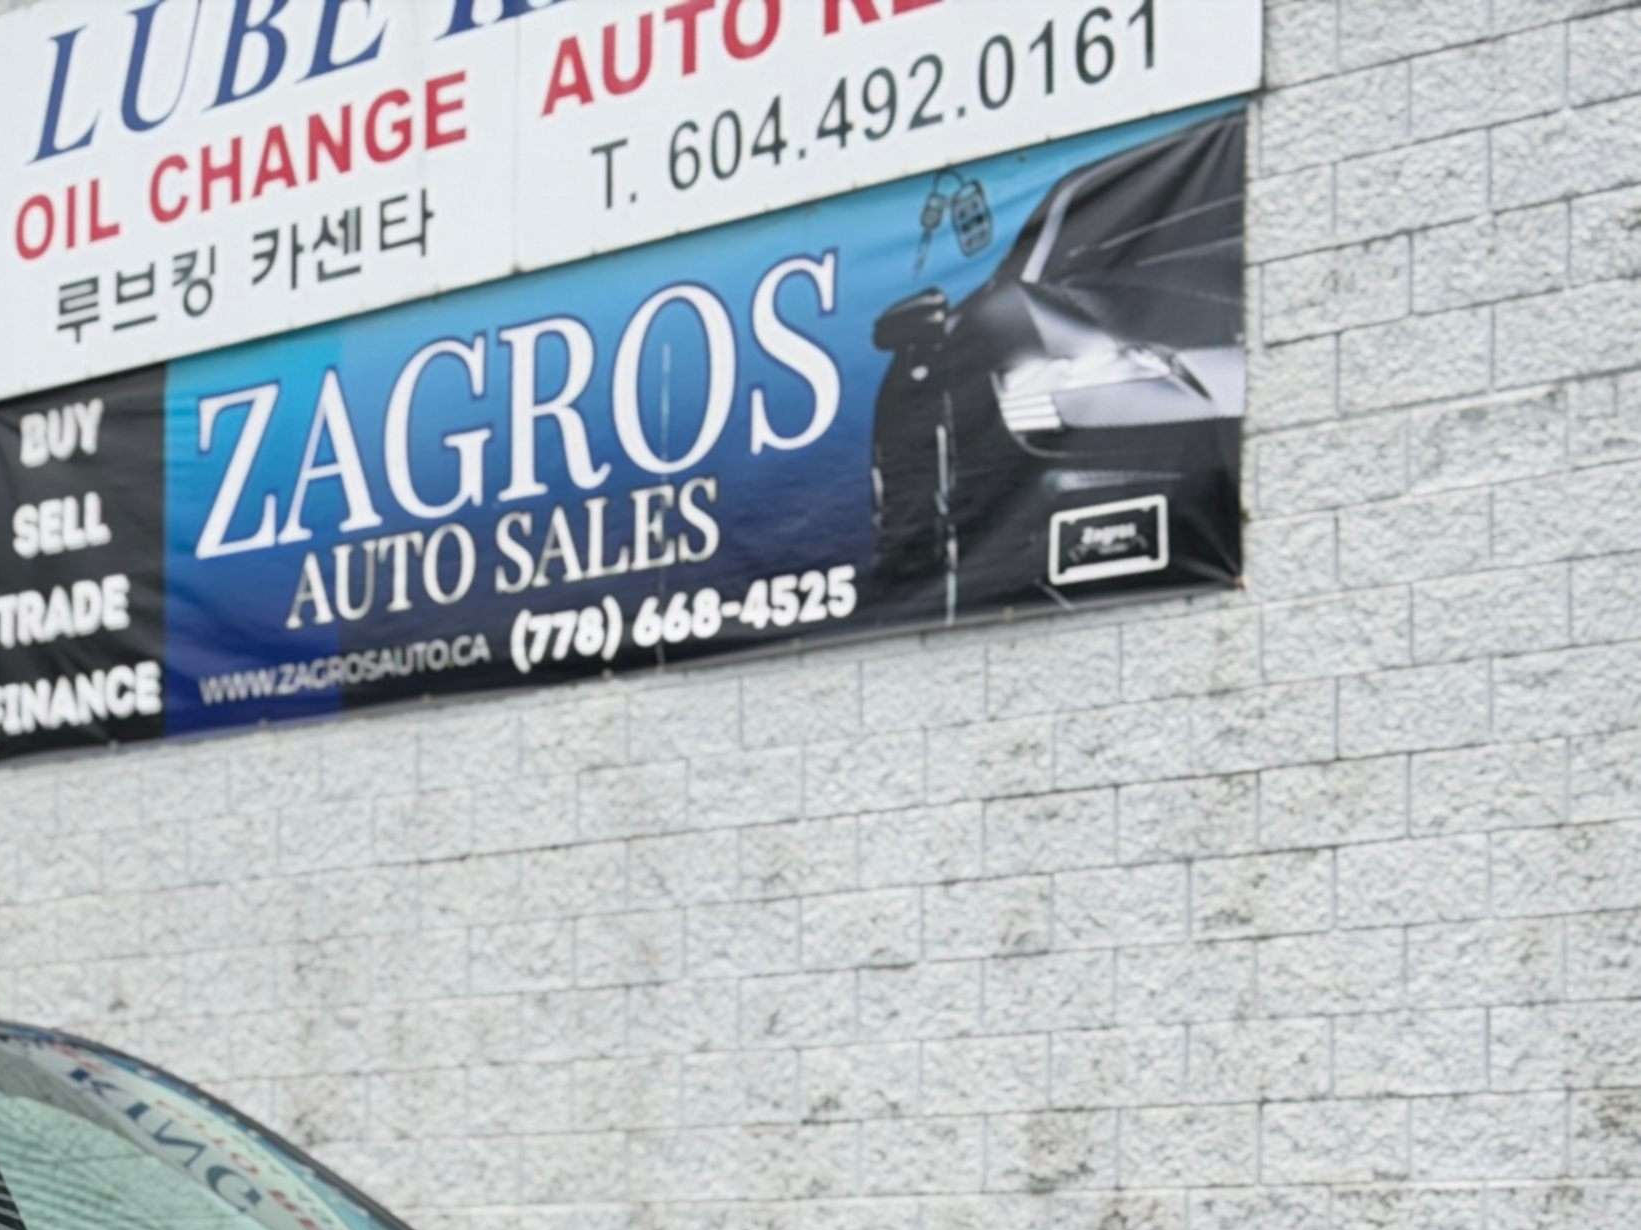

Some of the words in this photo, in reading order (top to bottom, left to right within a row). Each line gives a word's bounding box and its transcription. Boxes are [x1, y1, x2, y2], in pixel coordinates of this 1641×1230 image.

[14, 177, 121, 261] OIL
[148, 71, 468, 224] CHANGE
[541, 0, 780, 117] AUTO
[27, 0, 392, 166] LUBE
[590, 138, 638, 210] T.
[667, 0, 1157, 192] 604.492.0161
[56, 244, 217, 345] 루브킹
[251, 188, 435, 291] 카센타
[19, 398, 104, 467] BUY
[194, 247, 842, 560] ZAGROS
[11, 492, 110, 559] SELL
[285, 523, 477, 630] AUTO
[494, 475, 721, 595] SALES
[198, 631, 491, 706] WWW.ZAGROSAUTO.CA
[509, 594, 623, 673] (778)
[632, 565, 857, 649] 668-4525
